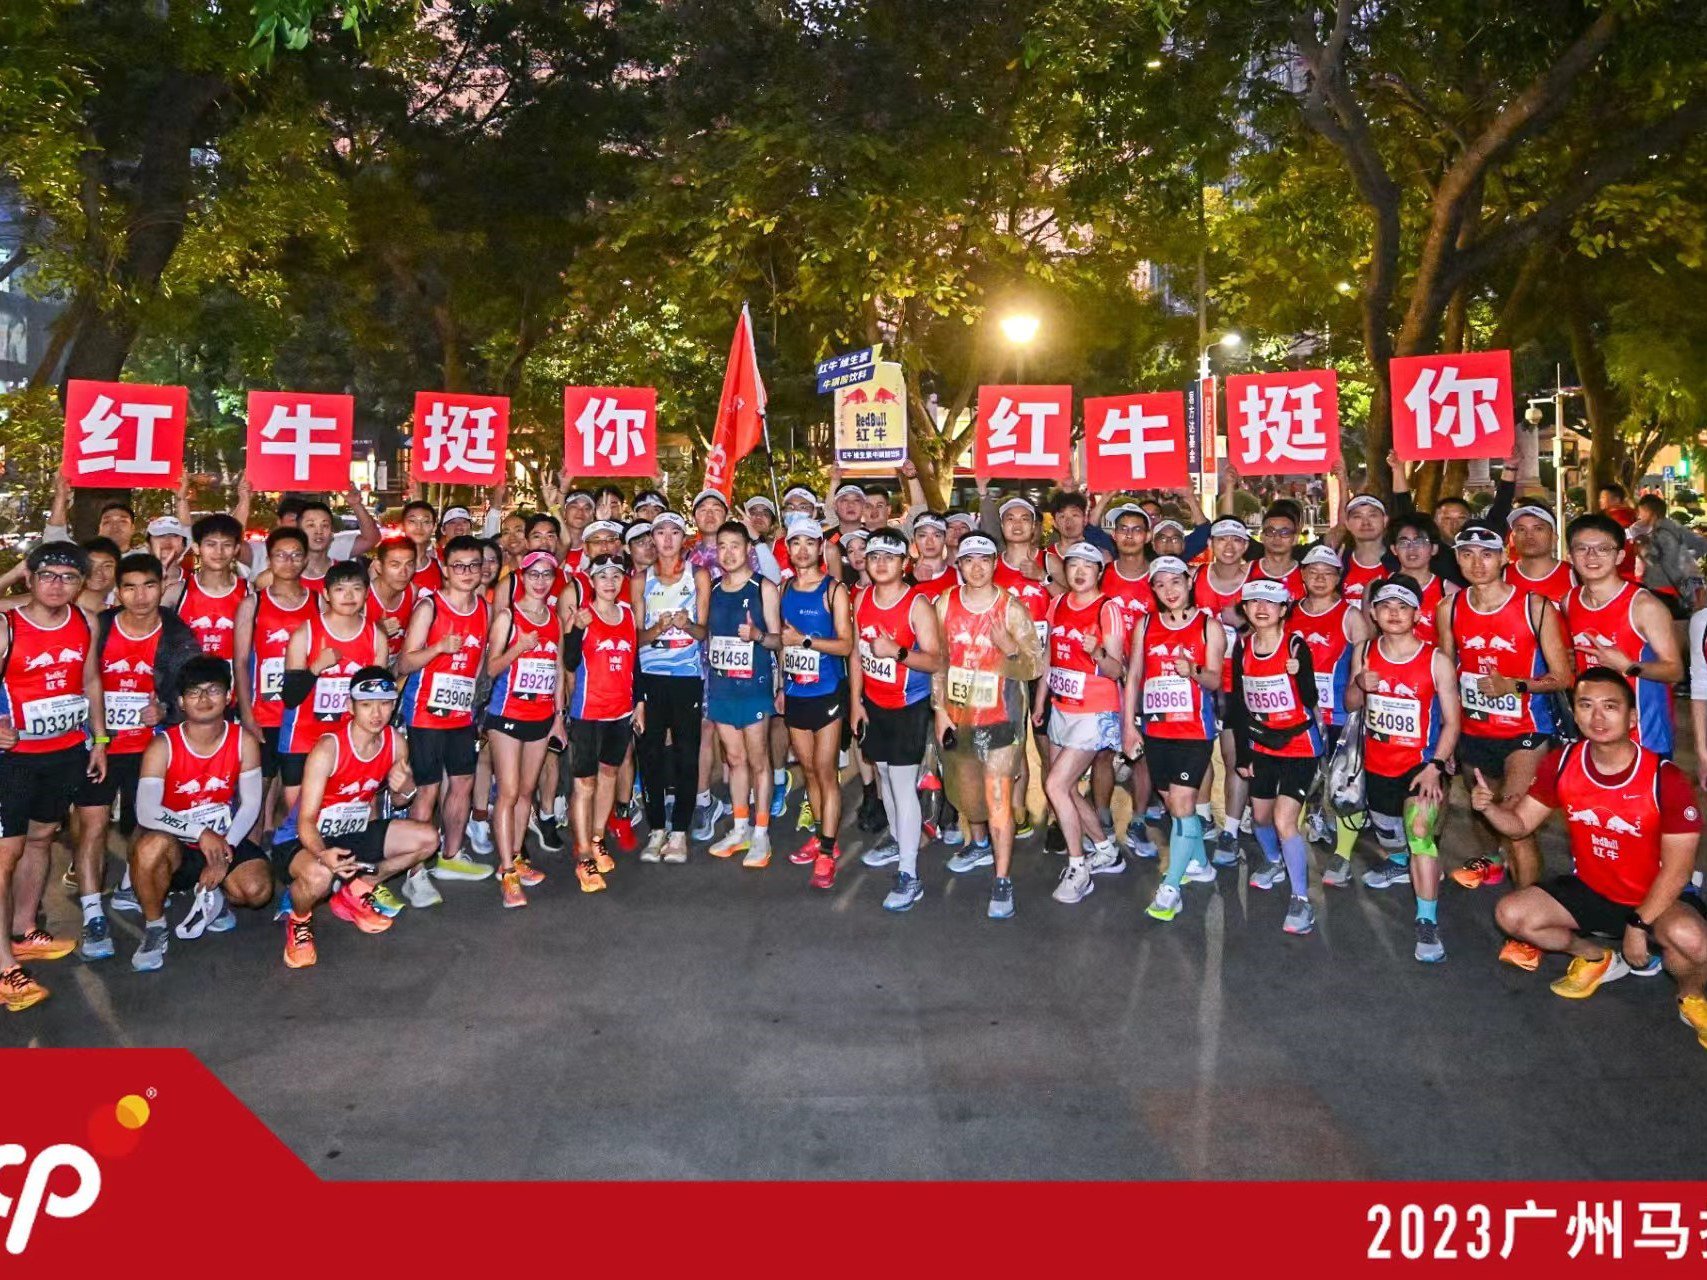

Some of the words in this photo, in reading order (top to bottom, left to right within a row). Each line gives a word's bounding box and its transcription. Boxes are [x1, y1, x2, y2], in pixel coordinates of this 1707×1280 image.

[1239, 382, 1327, 465] 挺
[1404, 366, 1500, 449] 你
[78, 394, 173, 475] 红
[261, 404, 341, 481] 牛
[422, 402, 498, 474] 挺
[575, 397, 647, 467] 你
[856, 428, 887, 442] 红牛
[987, 397, 1060, 466] 红
[1097, 404, 1175, 479] 牛
[519, 672, 556, 690] B9212
[712, 650, 749, 666] B1458
[435, 688, 472, 707] E3906
[1146, 691, 1188, 709] D8966
[1368, 710, 1414, 733] E4098
[321, 817, 366, 837] B3482
[1593, 846, 1620, 861] 红牛
